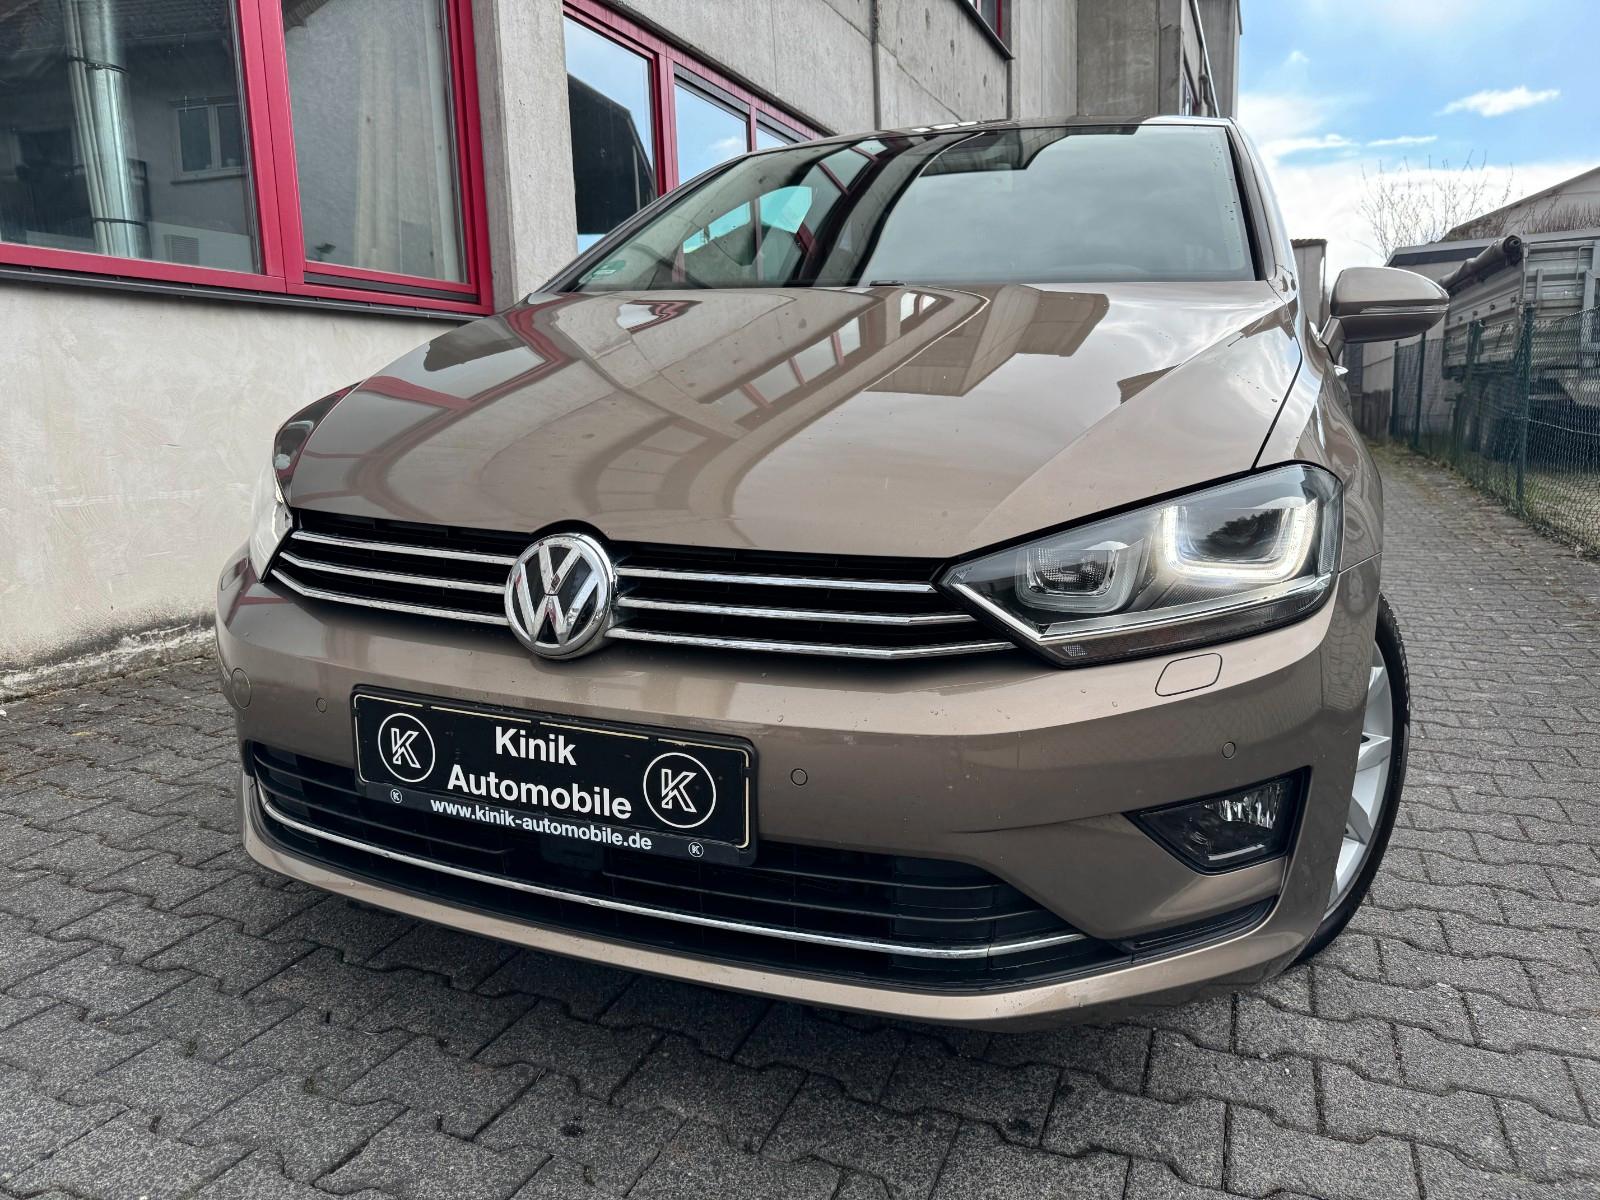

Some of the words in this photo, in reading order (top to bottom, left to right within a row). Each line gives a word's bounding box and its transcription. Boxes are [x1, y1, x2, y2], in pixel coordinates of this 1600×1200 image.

[512, 543, 601, 646] VW
[391, 727, 421, 769] K
[494, 725, 577, 766] Kinik
[447, 763, 632, 819] Automobile
[661, 768, 697, 813] K
[430, 799, 653, 850] www.kinik-automobile.de
